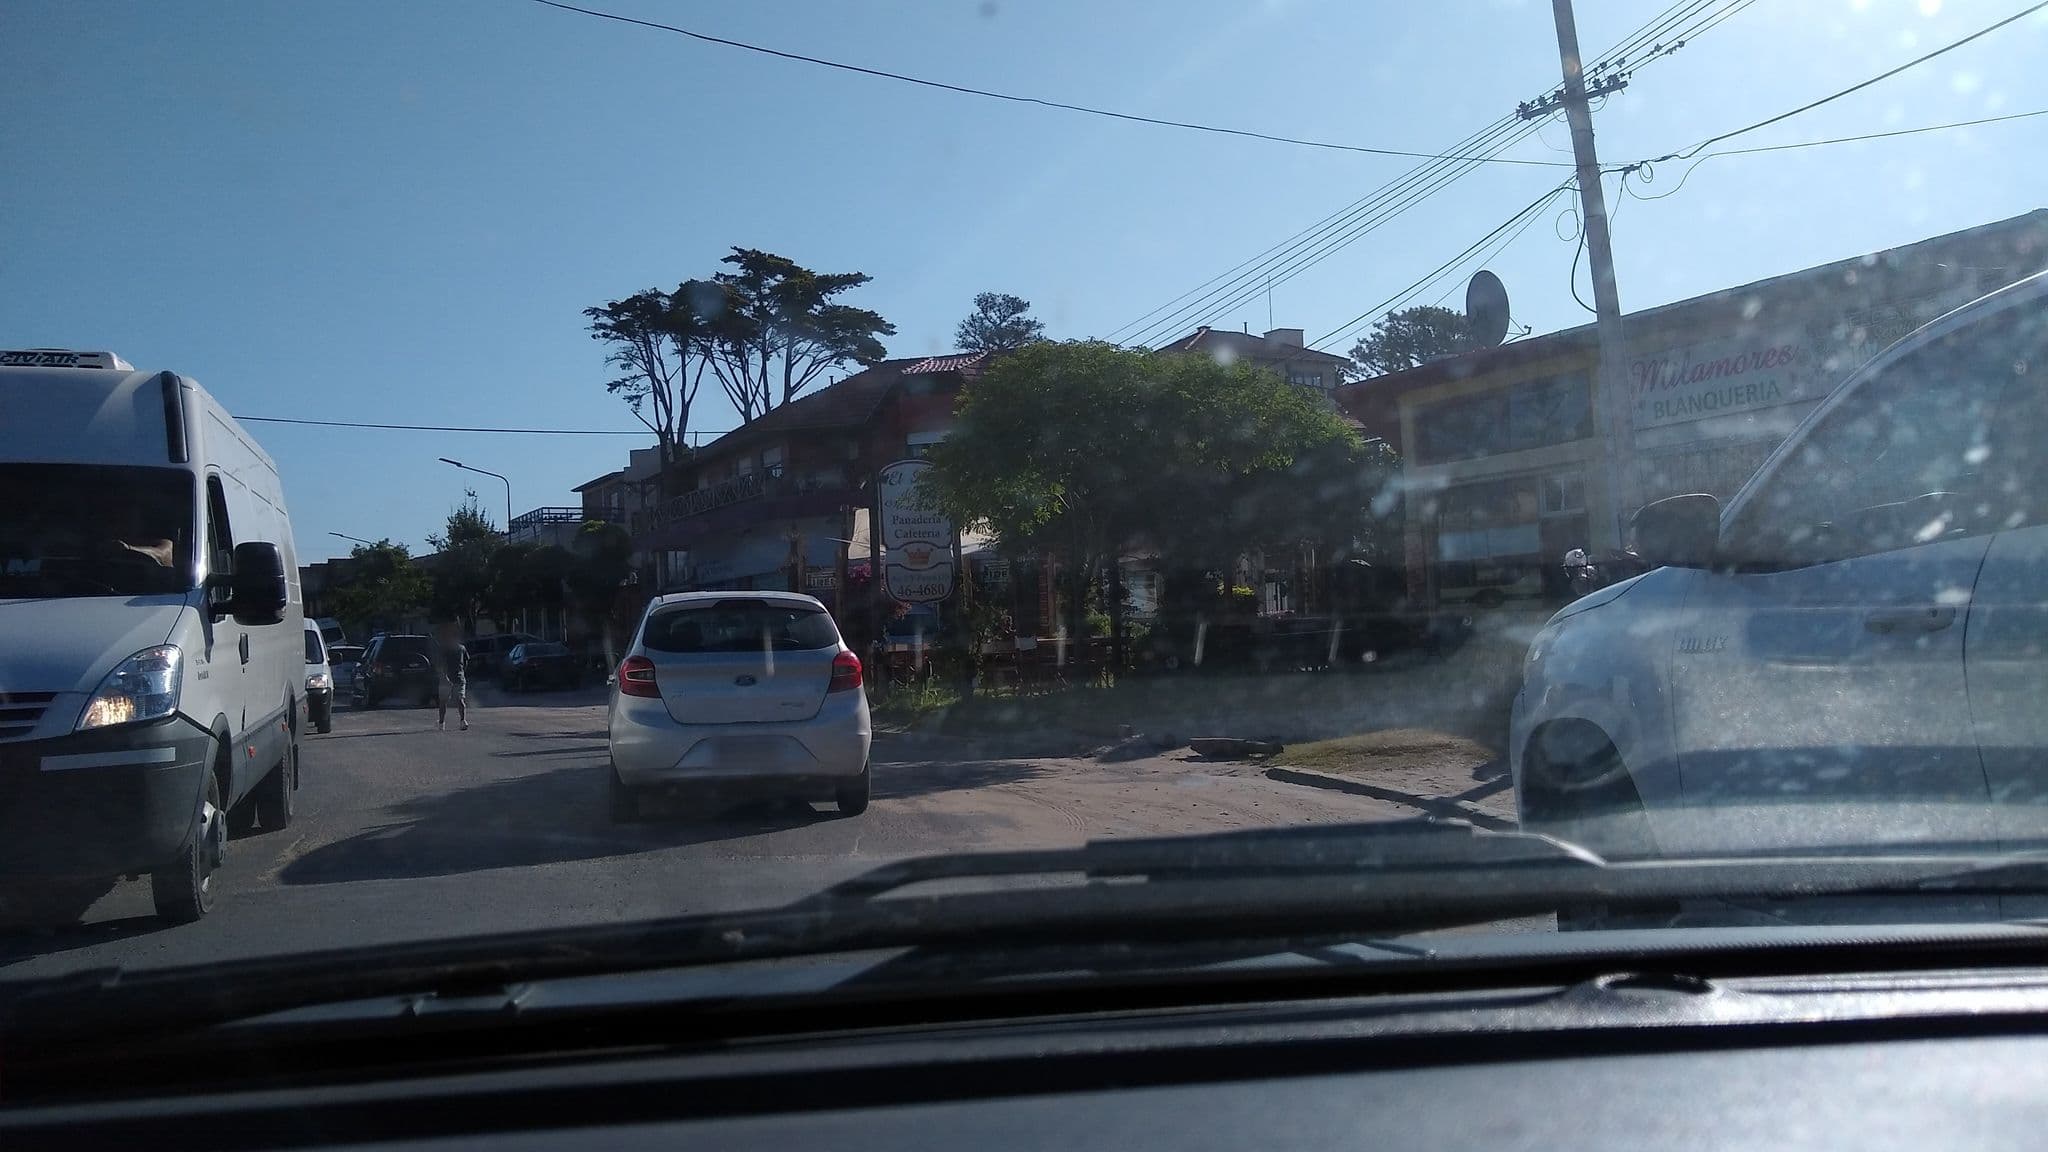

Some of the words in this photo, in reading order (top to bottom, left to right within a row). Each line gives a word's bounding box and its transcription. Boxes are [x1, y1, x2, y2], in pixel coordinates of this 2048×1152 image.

[1632, 344, 1799, 393] Milamores
[1654, 379, 1781, 420] BLANQUERIA
[897, 583, 945, 597] 46-4680
